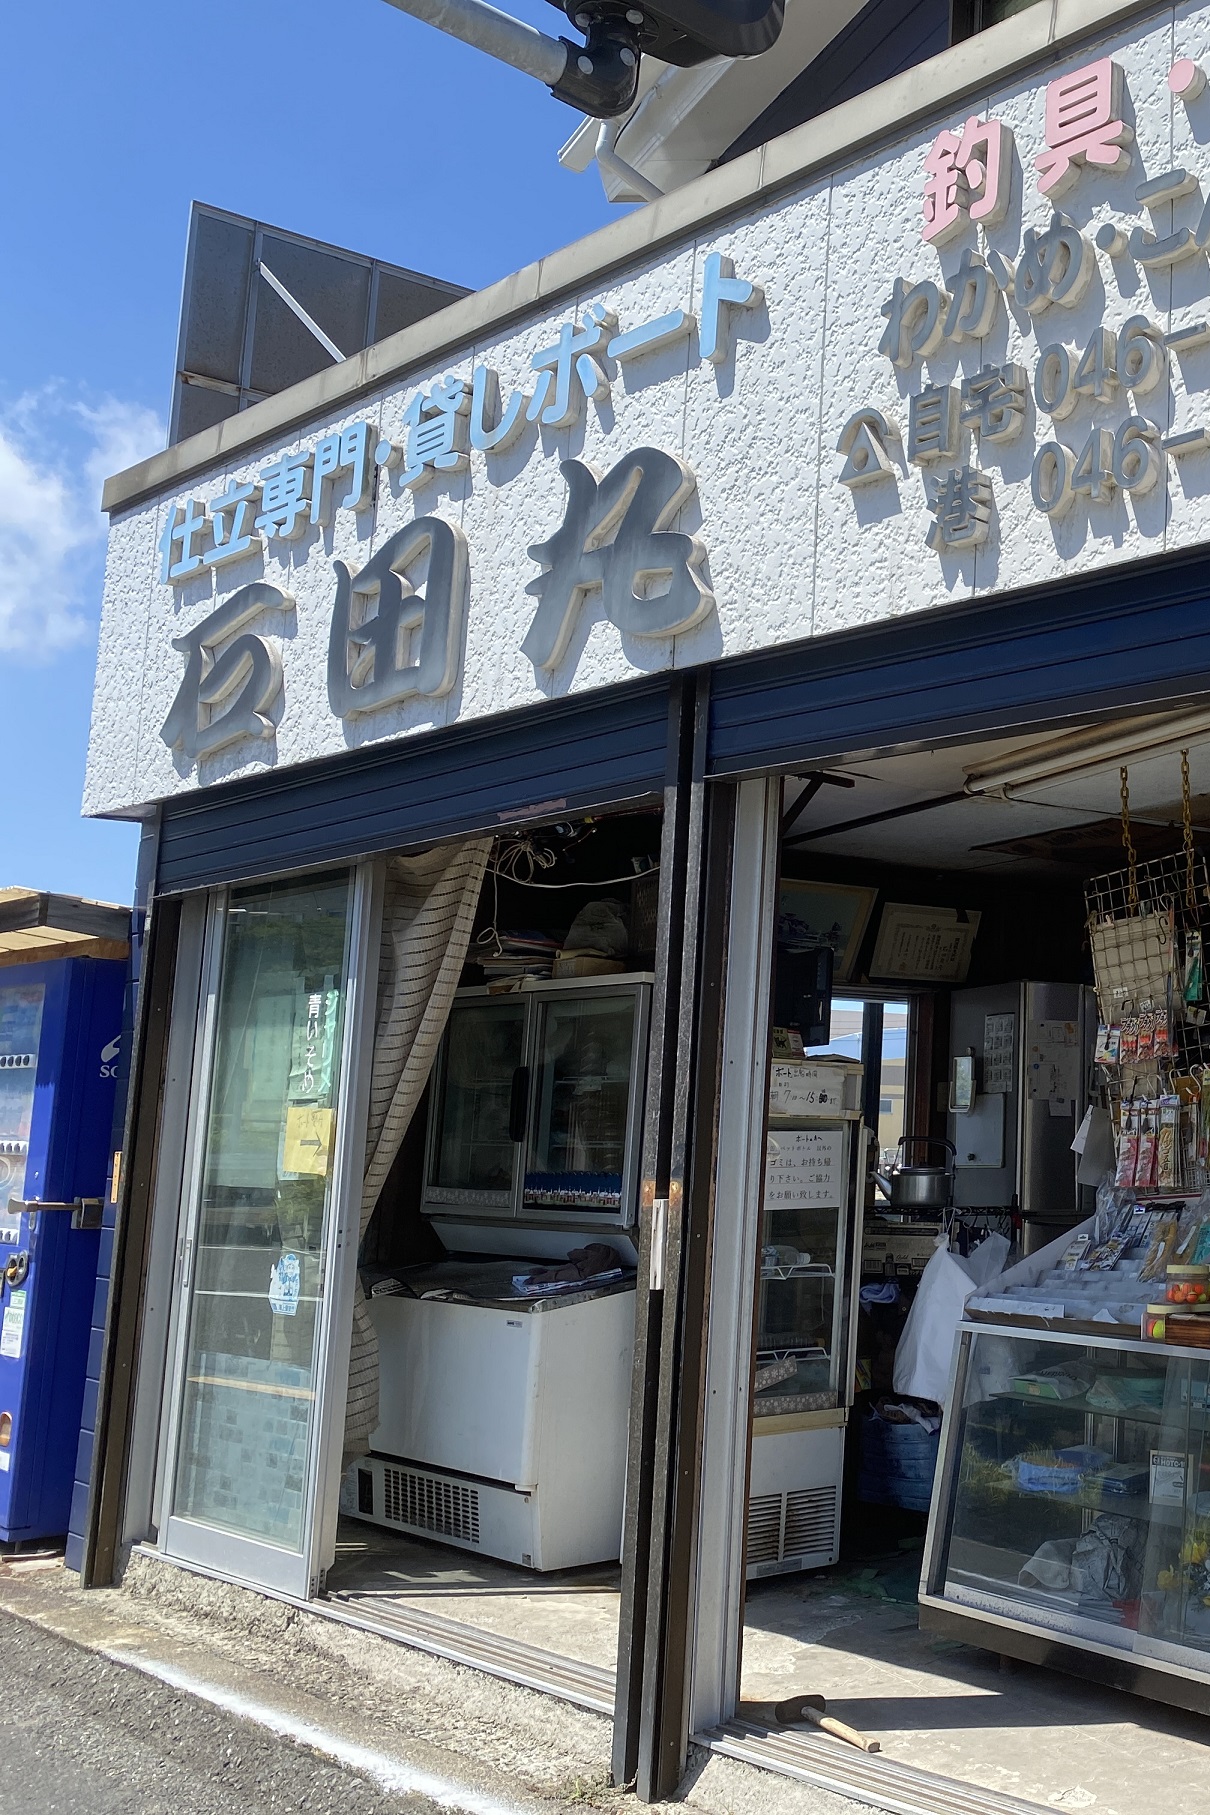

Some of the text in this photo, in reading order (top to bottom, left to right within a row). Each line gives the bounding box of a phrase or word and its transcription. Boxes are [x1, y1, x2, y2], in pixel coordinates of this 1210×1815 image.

[160, 251, 757, 585] 仕立専門・貸しボート
[908, 363, 1024, 464] 自宅
[923, 464, 990, 550] 港
